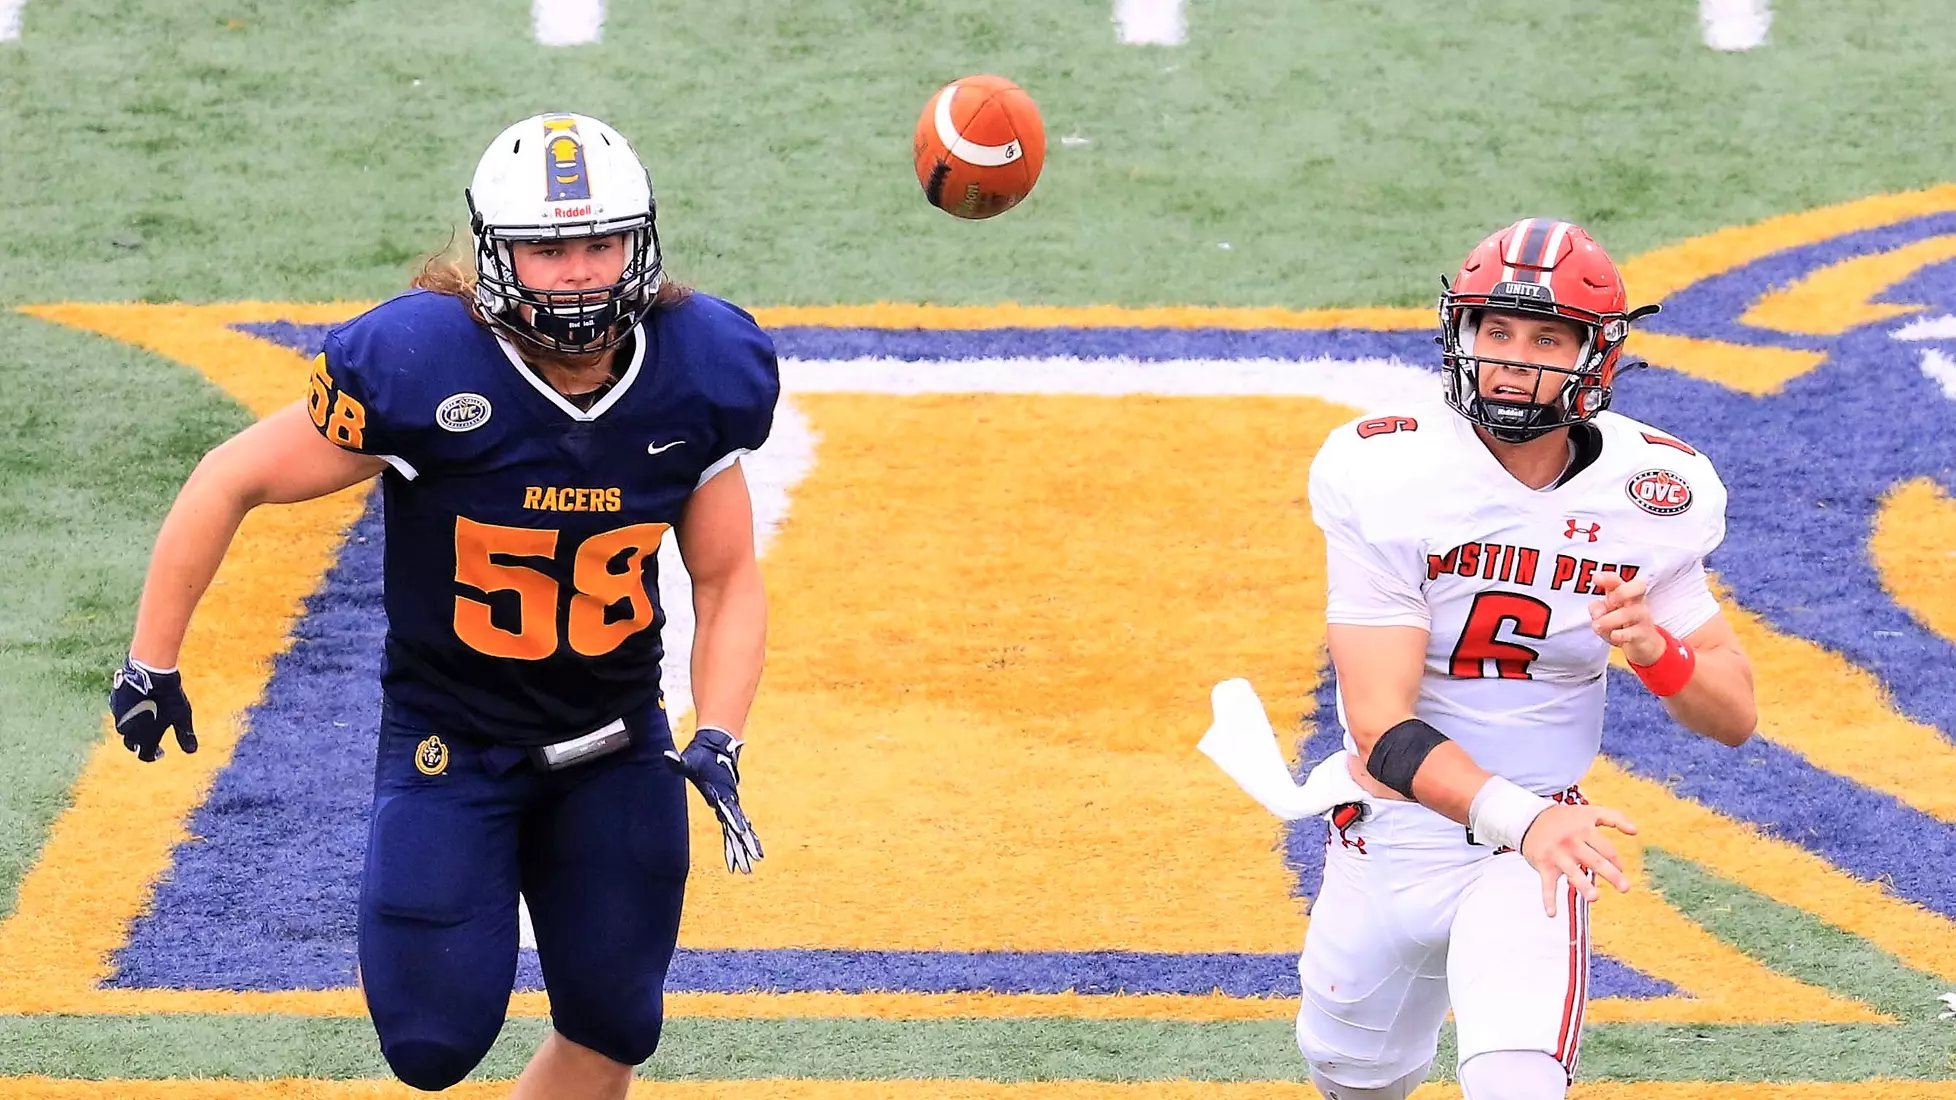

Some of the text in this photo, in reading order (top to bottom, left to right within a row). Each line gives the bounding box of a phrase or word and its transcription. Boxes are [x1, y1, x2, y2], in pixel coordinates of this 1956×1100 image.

[554, 204, 592, 218] Riddell
[1505, 283, 1540, 297] UNITY
[307, 351, 366, 449] 58
[450, 405, 477, 420] OVC
[522, 486, 622, 512] RACERS
[1640, 480, 1682, 503] OVC
[453, 514, 672, 661] 58
[1449, 590, 1552, 680] 6
